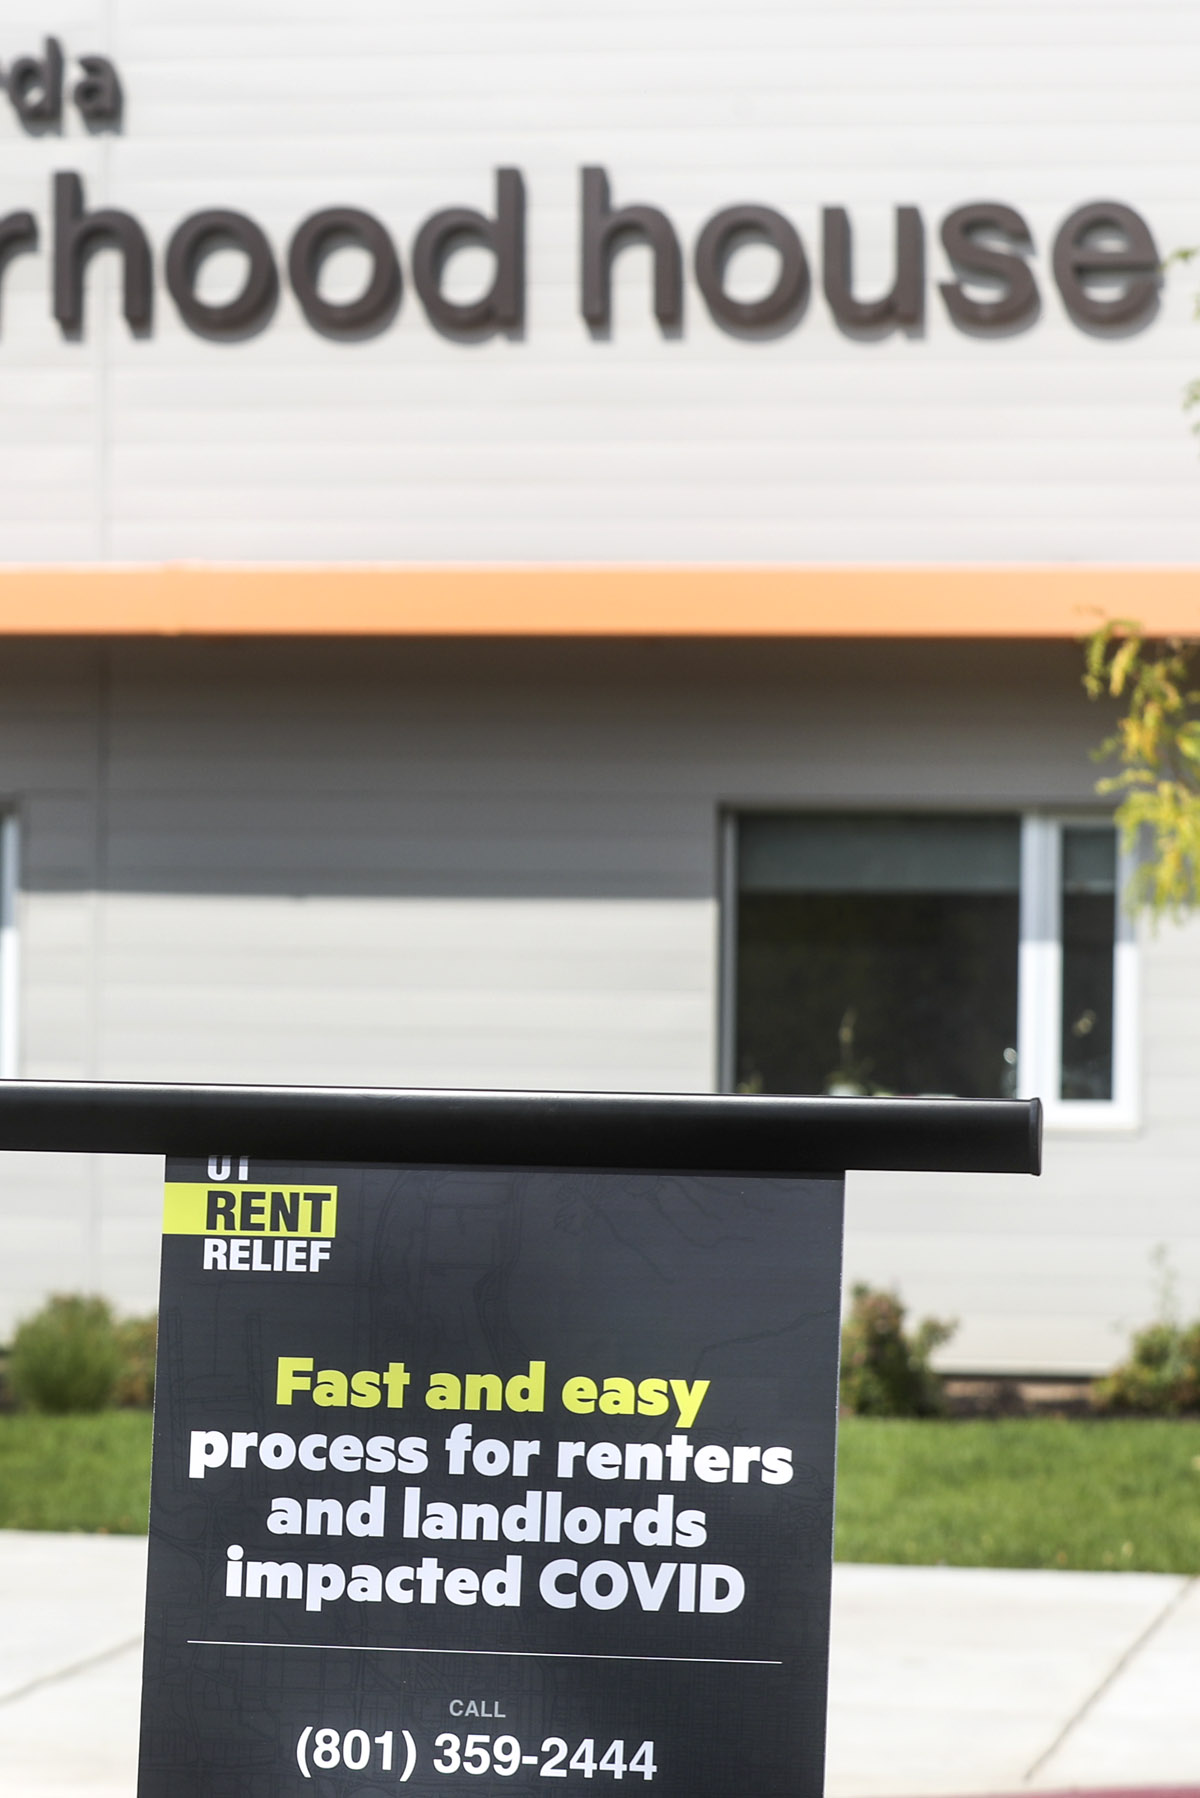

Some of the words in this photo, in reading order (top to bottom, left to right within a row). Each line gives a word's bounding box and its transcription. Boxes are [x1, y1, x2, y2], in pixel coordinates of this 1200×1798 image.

[580, 166, 1164, 342] house
[205, 1190, 332, 1233] RENT
[202, 1238, 332, 1273] RELIEF
[276, 1356, 411, 1409] Fast
[425, 1360, 546, 1413] and
[561, 1376, 711, 1429] easy
[188, 1430, 429, 1479] process
[444, 1422, 541, 1477] for
[556, 1434, 794, 1485] renters
[266, 1485, 387, 1538] and
[402, 1486, 708, 1548] landlords
[225, 1544, 523, 1612] impacted
[538, 1558, 746, 1614] COVID
[448, 1699, 507, 1719] CALL
[296, 1725, 417, 1783] (801)
[432, 1732, 658, 1781] 359-2444
